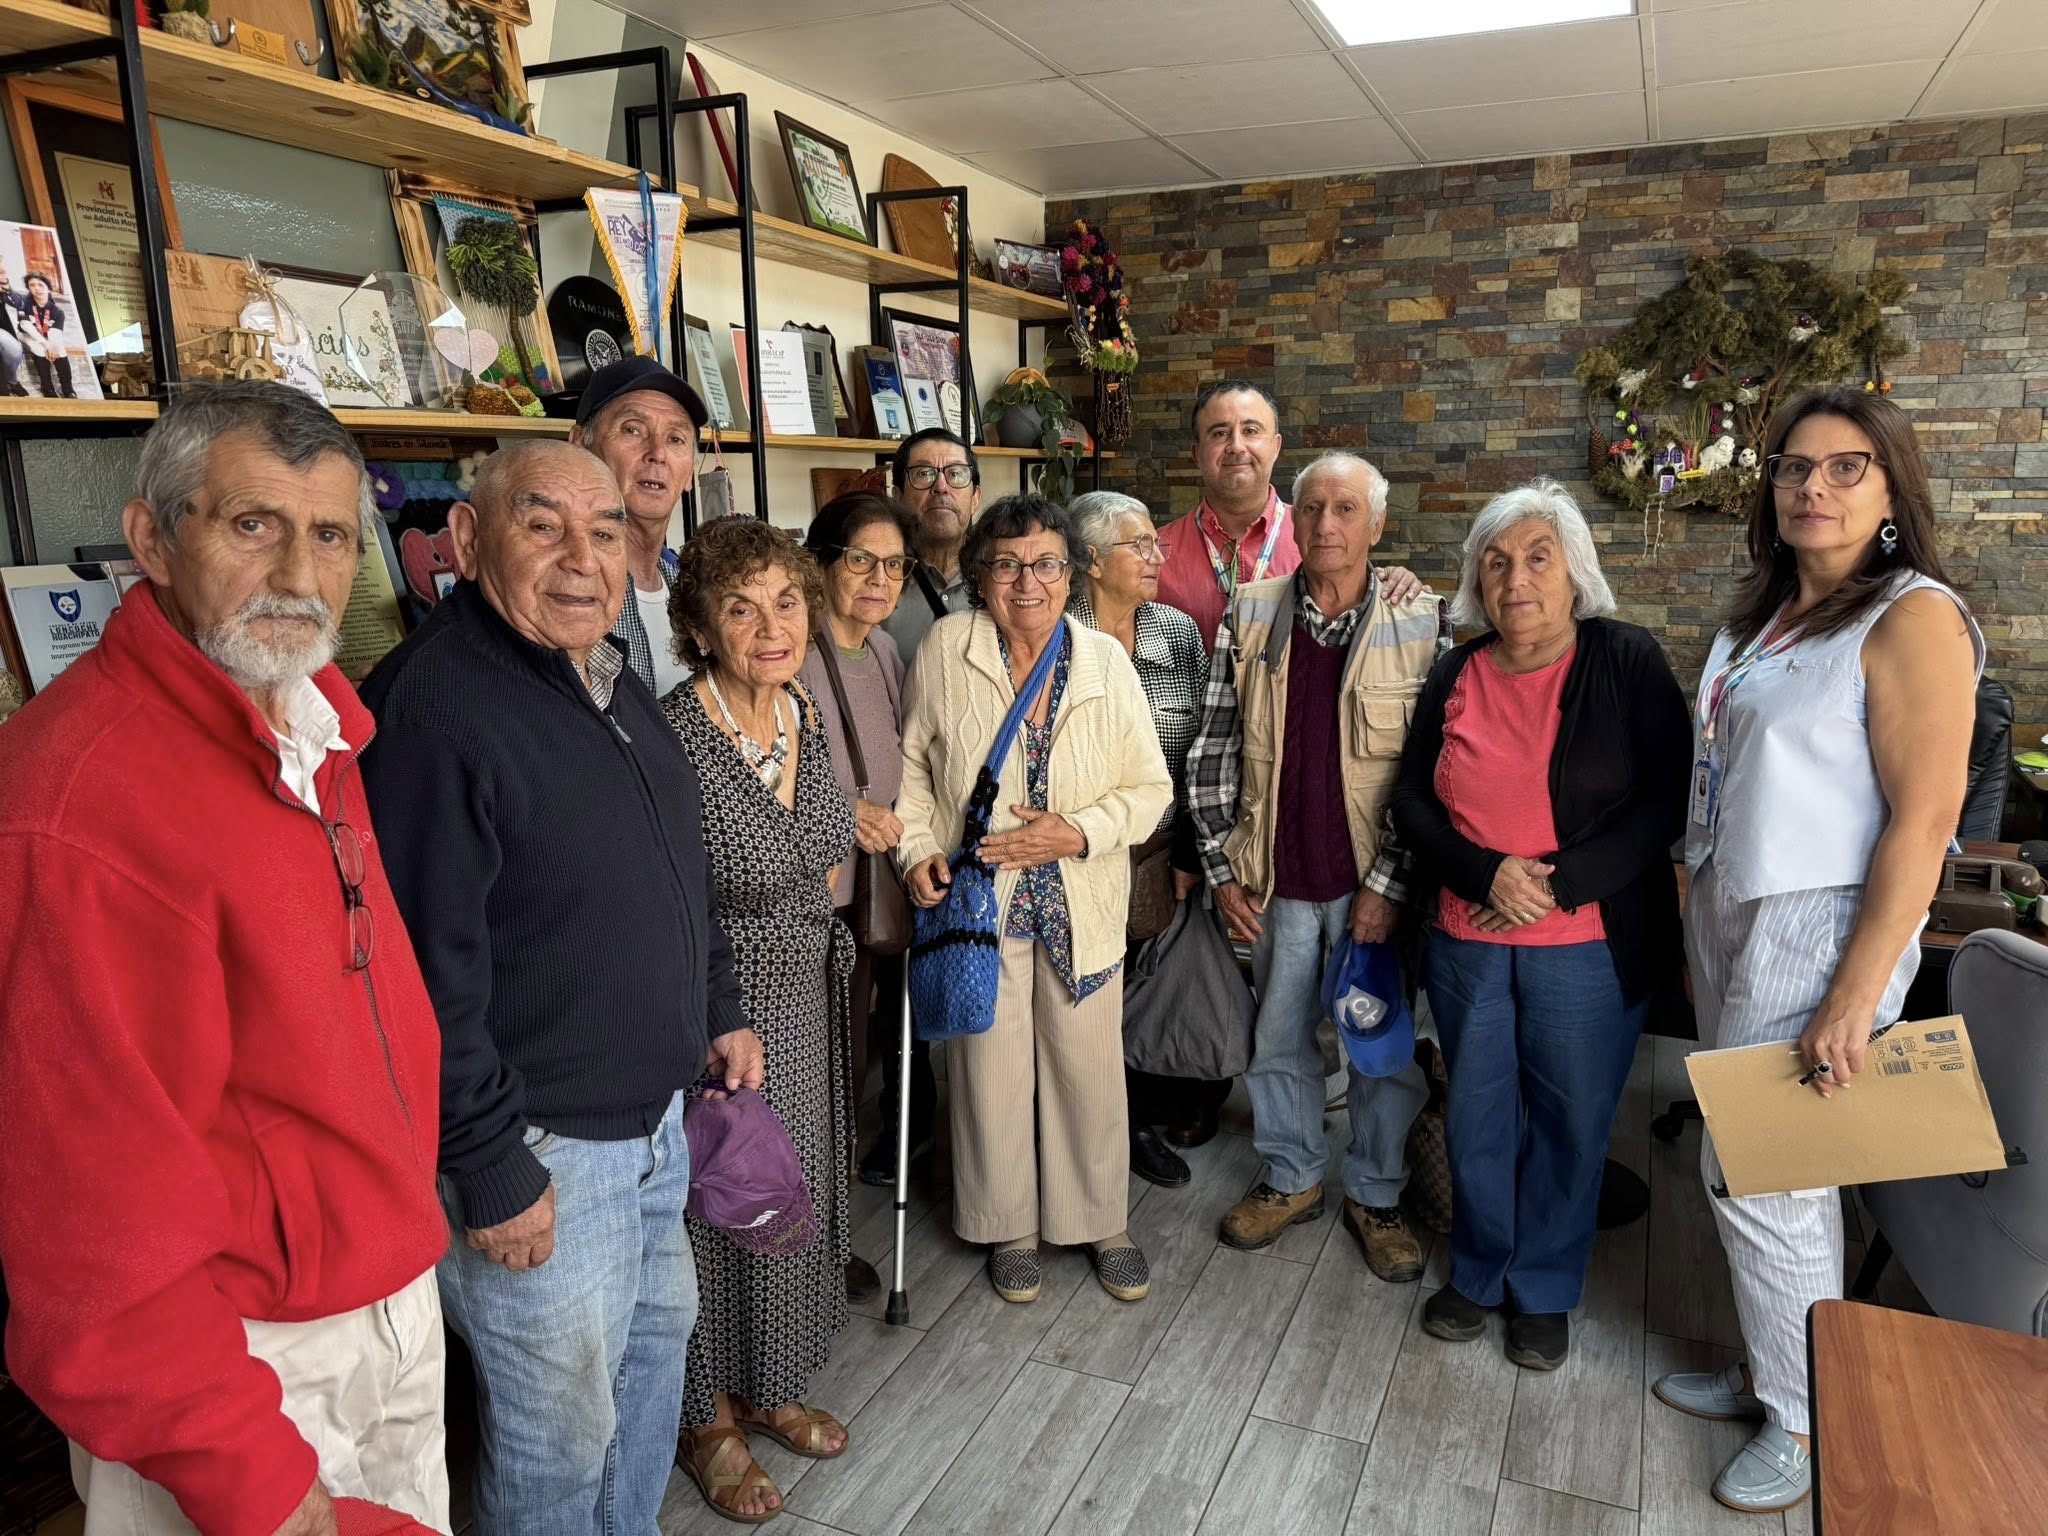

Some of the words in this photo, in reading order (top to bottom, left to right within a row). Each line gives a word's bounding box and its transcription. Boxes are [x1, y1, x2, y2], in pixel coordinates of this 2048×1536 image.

[76, 203, 116, 217] Provincial
[94, 215, 120, 225] Adulto
[121, 219, 137, 228] May
[607, 219, 627, 236] REY
[568, 295, 622, 321] RAMON
[50, 623, 99, 634] LONCOCHE
[51, 629, 100, 641] HUACHIPATO
